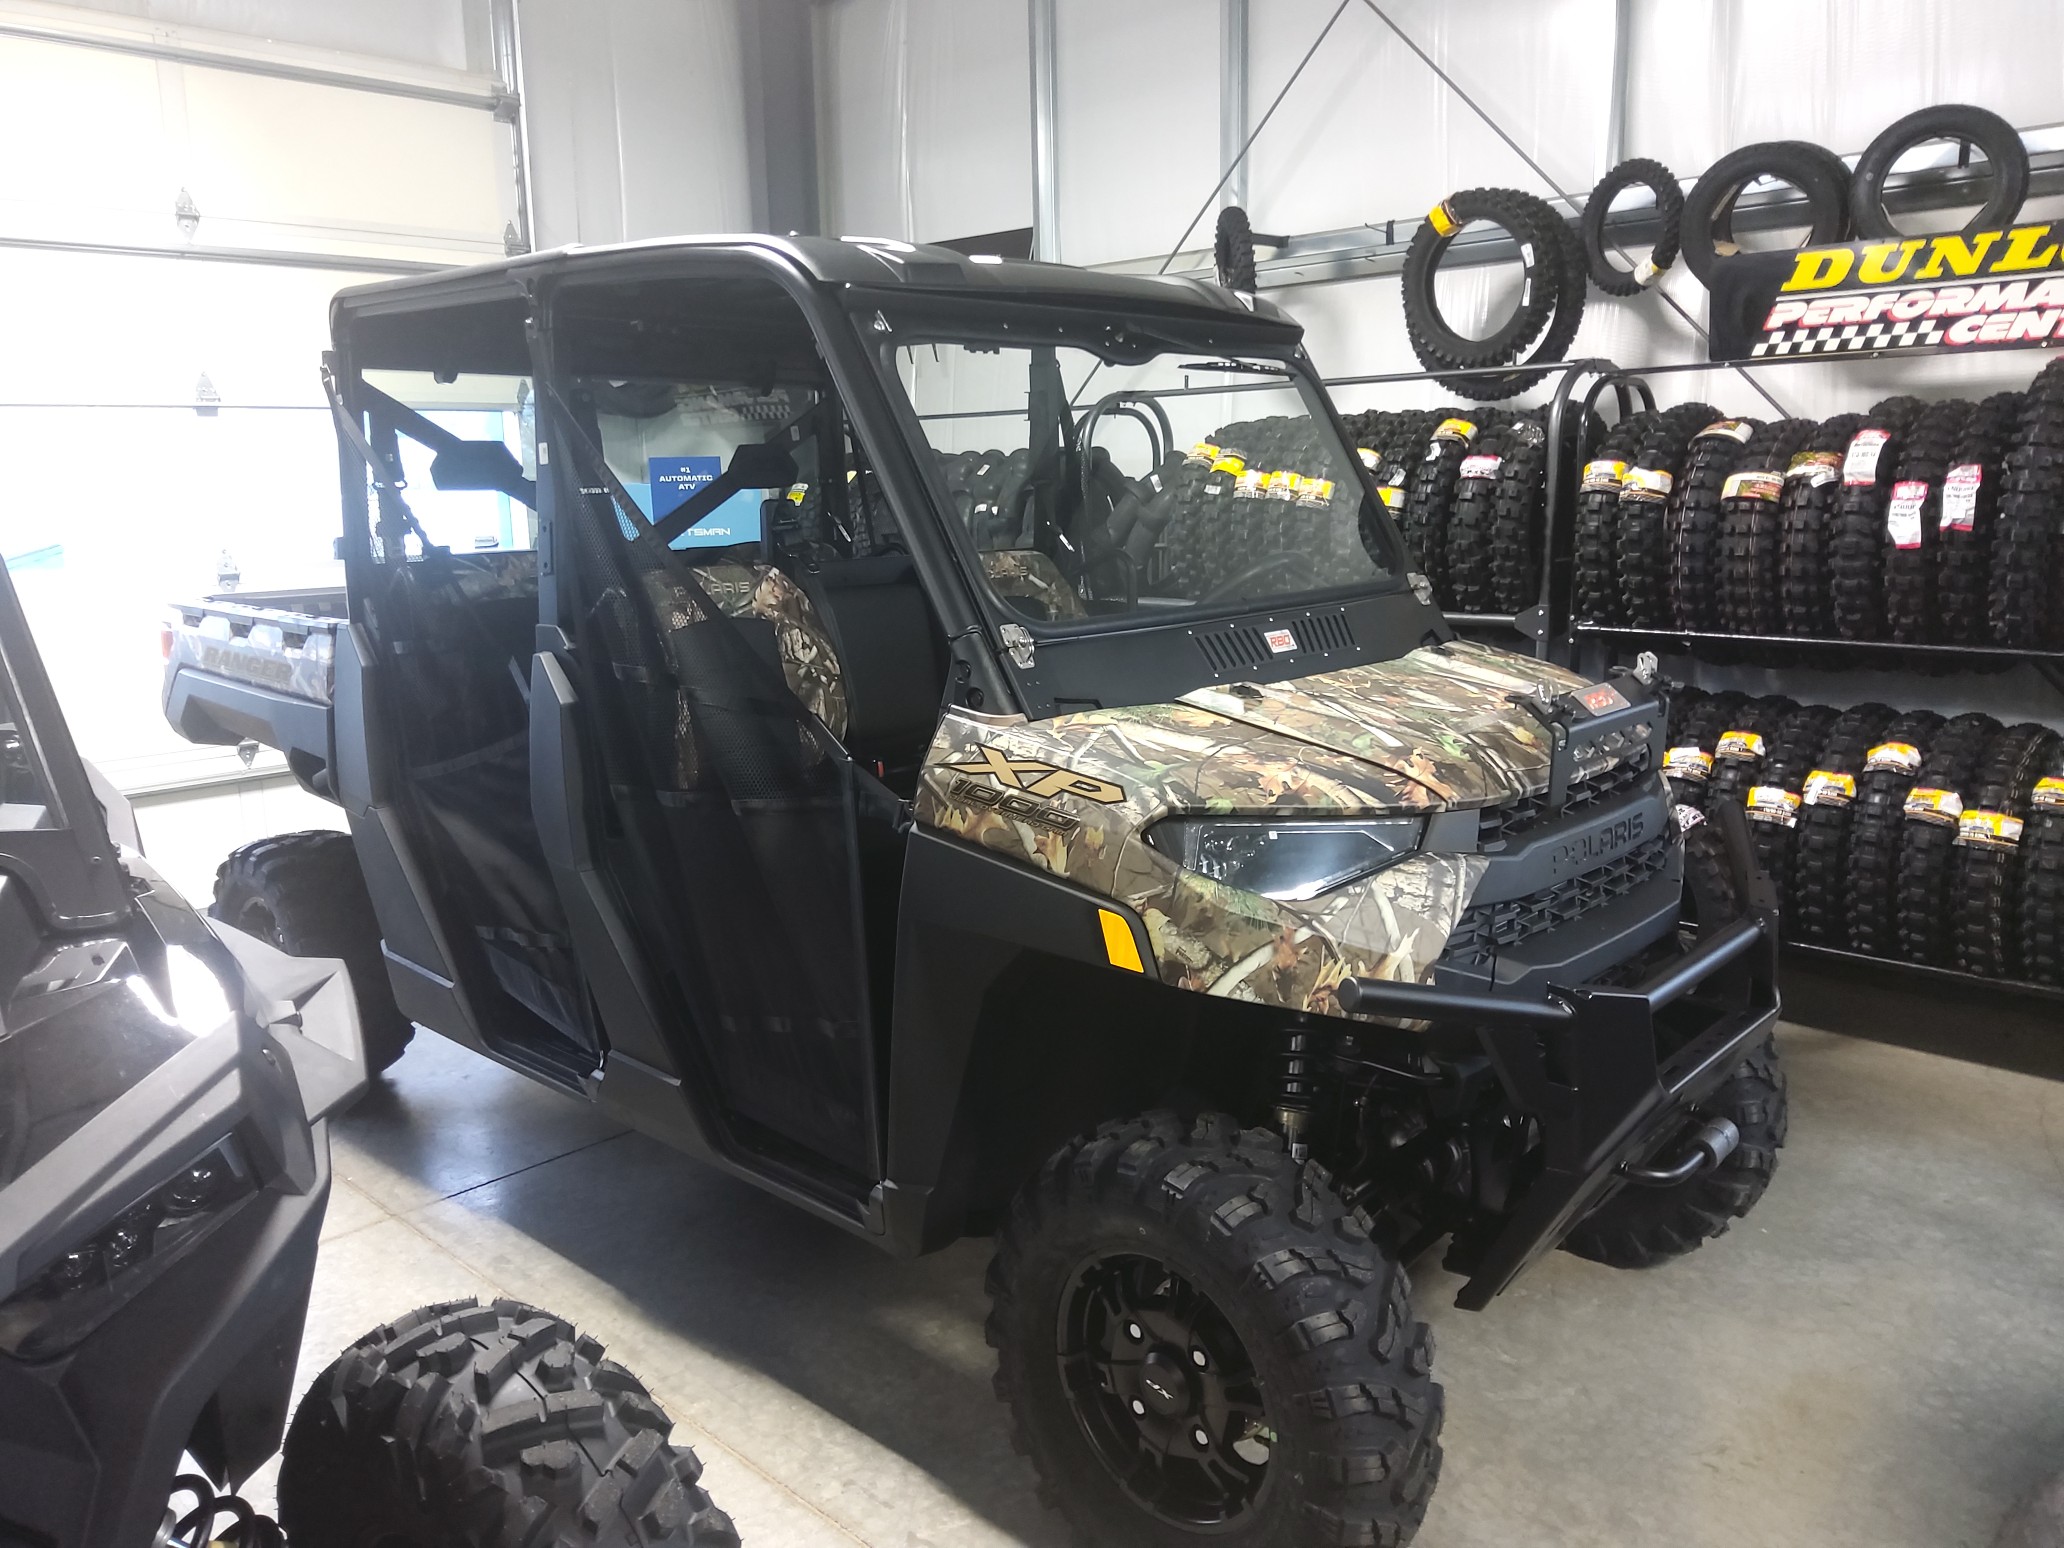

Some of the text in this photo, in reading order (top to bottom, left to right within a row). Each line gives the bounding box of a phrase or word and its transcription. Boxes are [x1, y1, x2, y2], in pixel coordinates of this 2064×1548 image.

[1780, 225, 2064, 293] DUNL
[659, 474, 714, 483] AUTOMATIC
[681, 527, 731, 537] TSMAN
[202, 646, 293, 681] RANGER
[934, 741, 1127, 805] XP
[950, 777, 1081, 831] 1000
[1551, 811, 1645, 876] POLARIS
